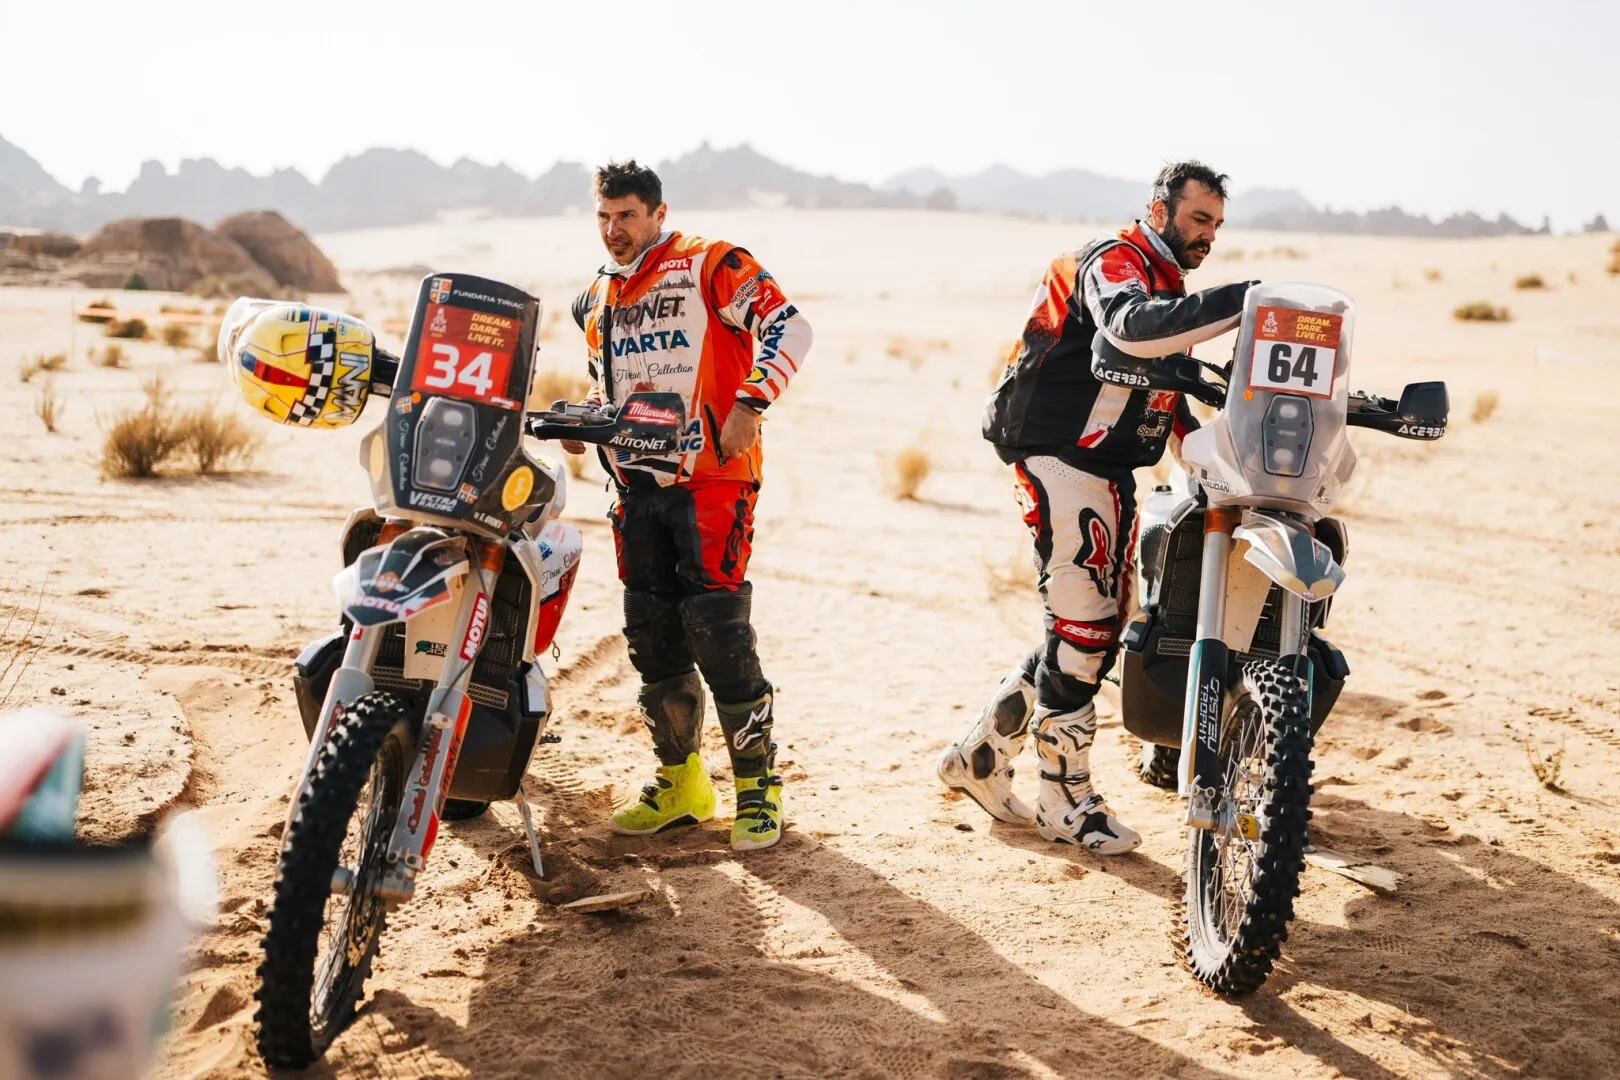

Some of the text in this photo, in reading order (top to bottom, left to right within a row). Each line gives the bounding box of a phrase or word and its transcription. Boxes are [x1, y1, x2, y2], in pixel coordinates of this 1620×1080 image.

[741, 278, 755, 293] West
[745, 285, 759, 300] Mare
[471, 313, 512, 329] DREAM.
[1297, 315, 1332, 328] DREAM.
[469, 323, 501, 336] DARE.
[1295, 331, 1327, 342] LIVE IT.
[1296, 324, 1323, 334] DARE.
[467, 332, 505, 347] LIVE IT.
[611, 329, 690, 357] VARTA
[424, 343, 493, 396] 34
[647, 362, 693, 379] Collection
[1267, 343, 1318, 387] 64
[1096, 367, 1150, 387] ACERBIS
[609, 436, 667, 450] AUTONET
[1062, 623, 1112, 641] astars
[1198, 684, 1209, 745] TROPHY
